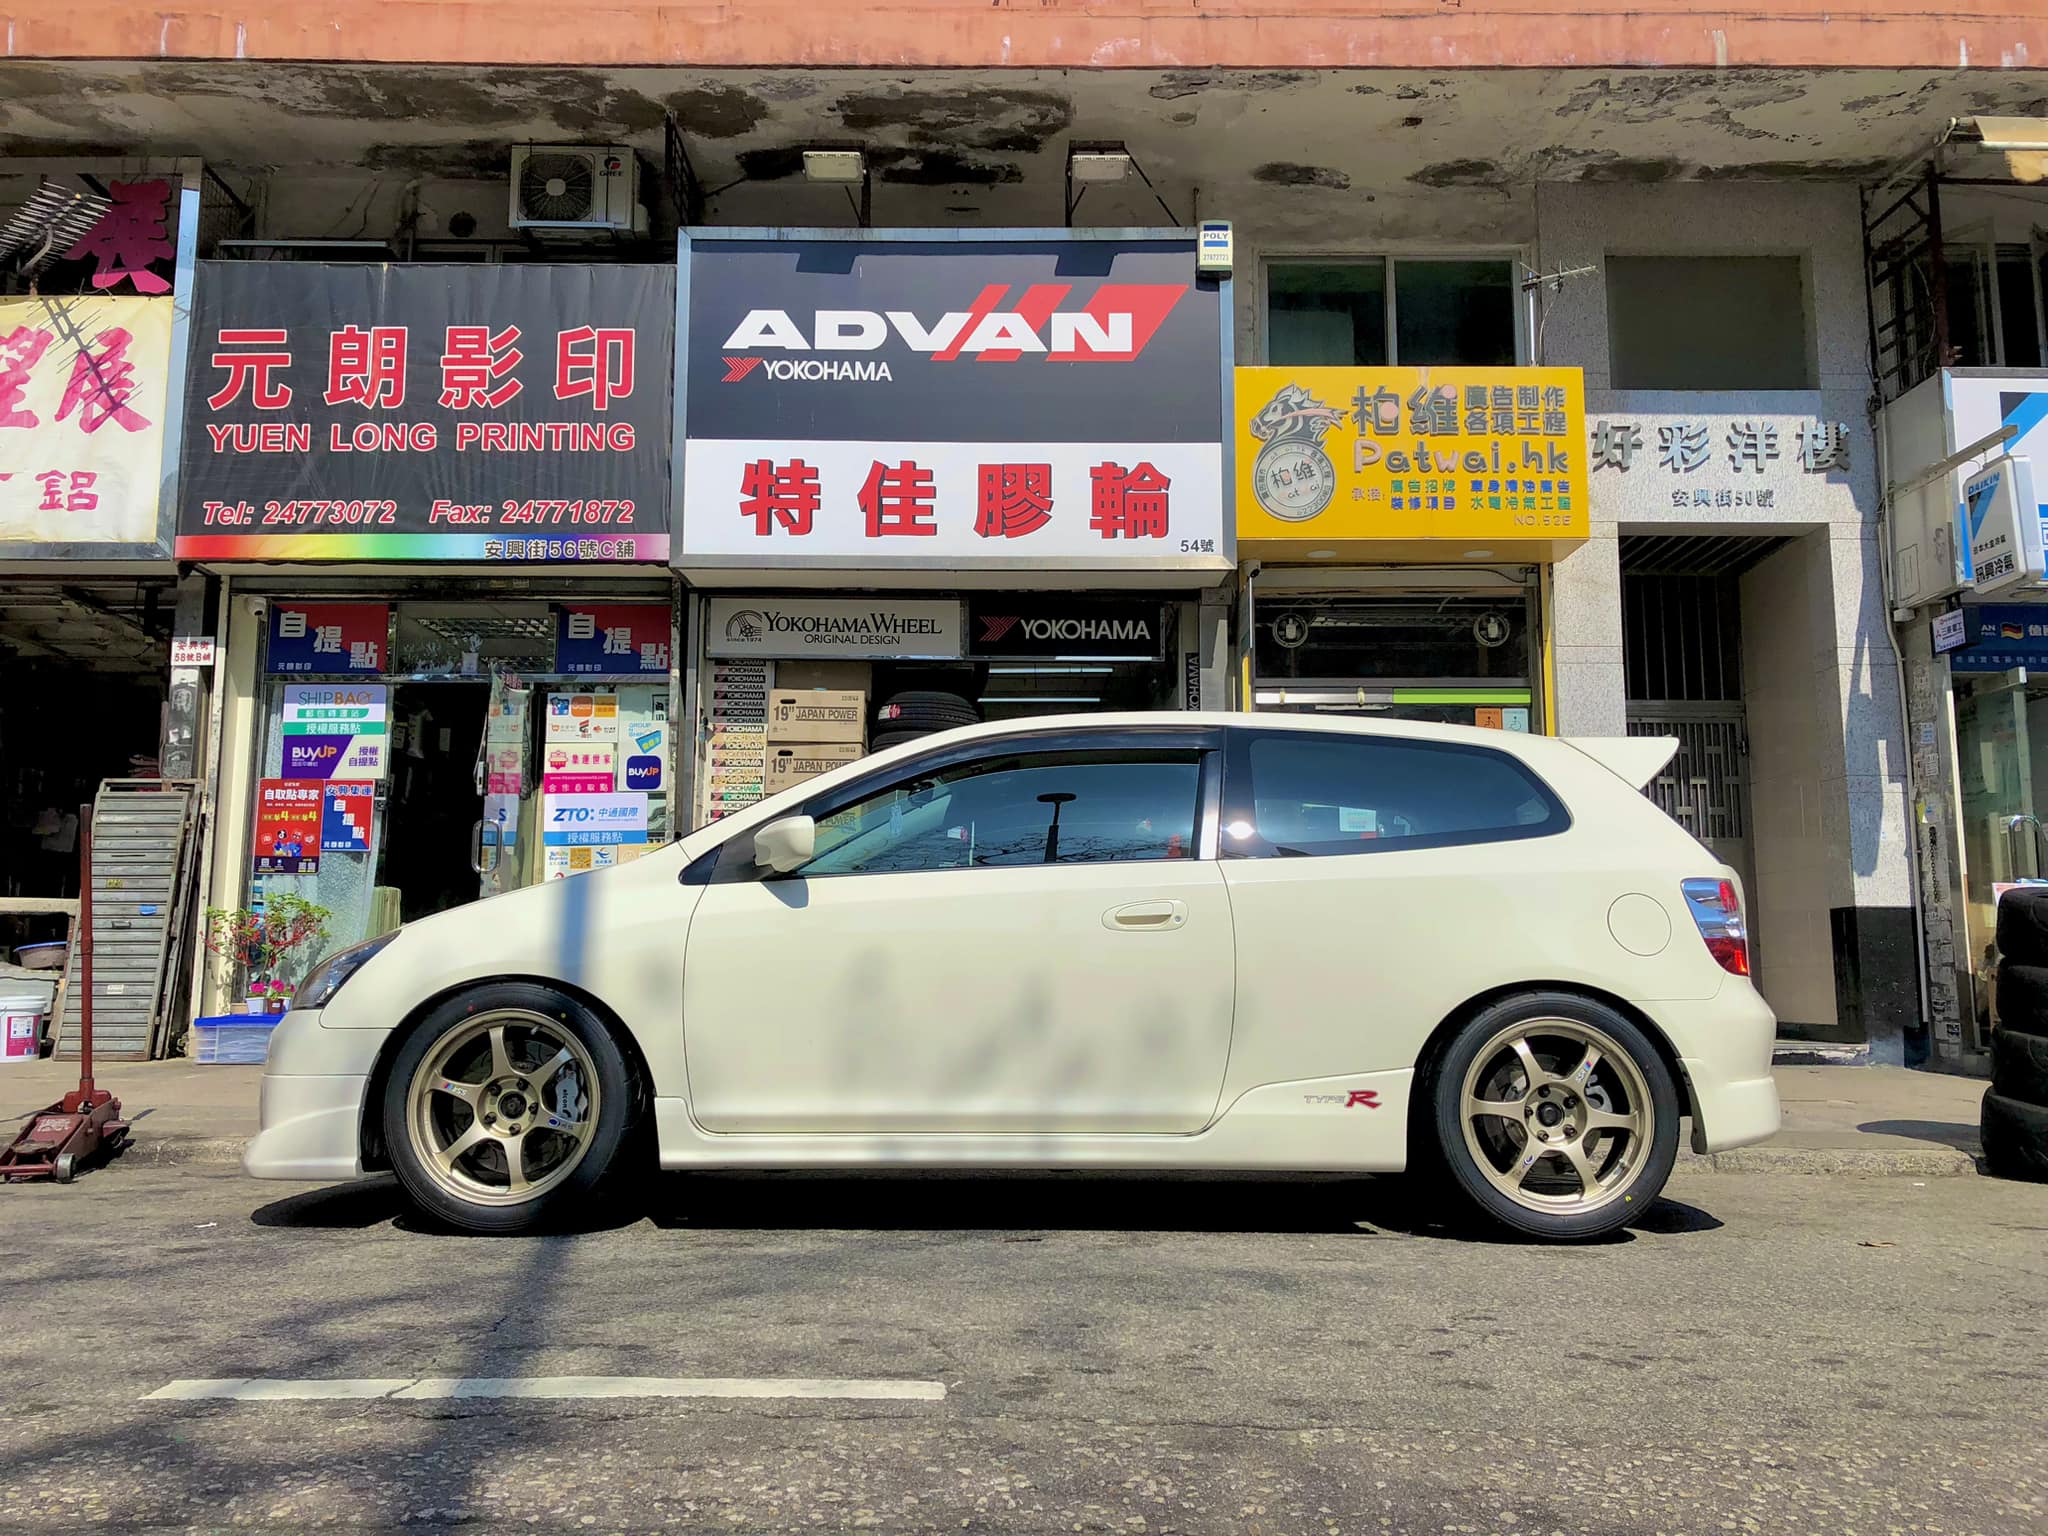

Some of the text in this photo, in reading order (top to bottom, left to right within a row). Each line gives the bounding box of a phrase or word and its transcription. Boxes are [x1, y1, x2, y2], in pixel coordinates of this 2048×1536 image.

[1203, 232, 1228, 240] POLY
[722, 309, 1134, 353] ADVAN
[207, 324, 637, 411] 元朗影印
[762, 359, 893, 382] YOKOHAMA
[1464, 410, 1567, 436] 各項工程
[207, 423, 637, 453] YUEN LONG PRINTING
[1591, 420, 1851, 474] 好彩洋樓
[1353, 438, 1569, 474] Patwai.hk
[1390, 479, 1456, 494] 廣告招牌
[1967, 471, 2000, 495] DAIKIN
[739, 458, 1172, 539] 特佳膠輪
[1671, 489, 1775, 508] 安興街50號
[202, 500, 636, 525] Tel: 24773072 Fax: 24771872
[484, 539, 637, 560] 安興街56號C舖
[1179, 539, 1215, 554] 54號
[762, 611, 943, 634] YOKOHAMA WHEEL
[1020, 618, 1151, 640] YOKOHAMA
[279, 611, 378, 669] 自提點
[567, 612, 668, 670] 自提點
[804, 633, 901, 645] ORIGINAL DESIGN
[1188, 655, 1200, 711] KOHAMA
[298, 690, 374, 706] SHIPBAO
[795, 709, 825, 720] JAPAN
[828, 709, 858, 720] POWER
[306, 722, 361, 735] 授權服務點
[793, 761, 823, 771] JAPAN
[264, 789, 320, 801] 自取點專家
[1303, 1089, 1383, 1110] TYPE R
